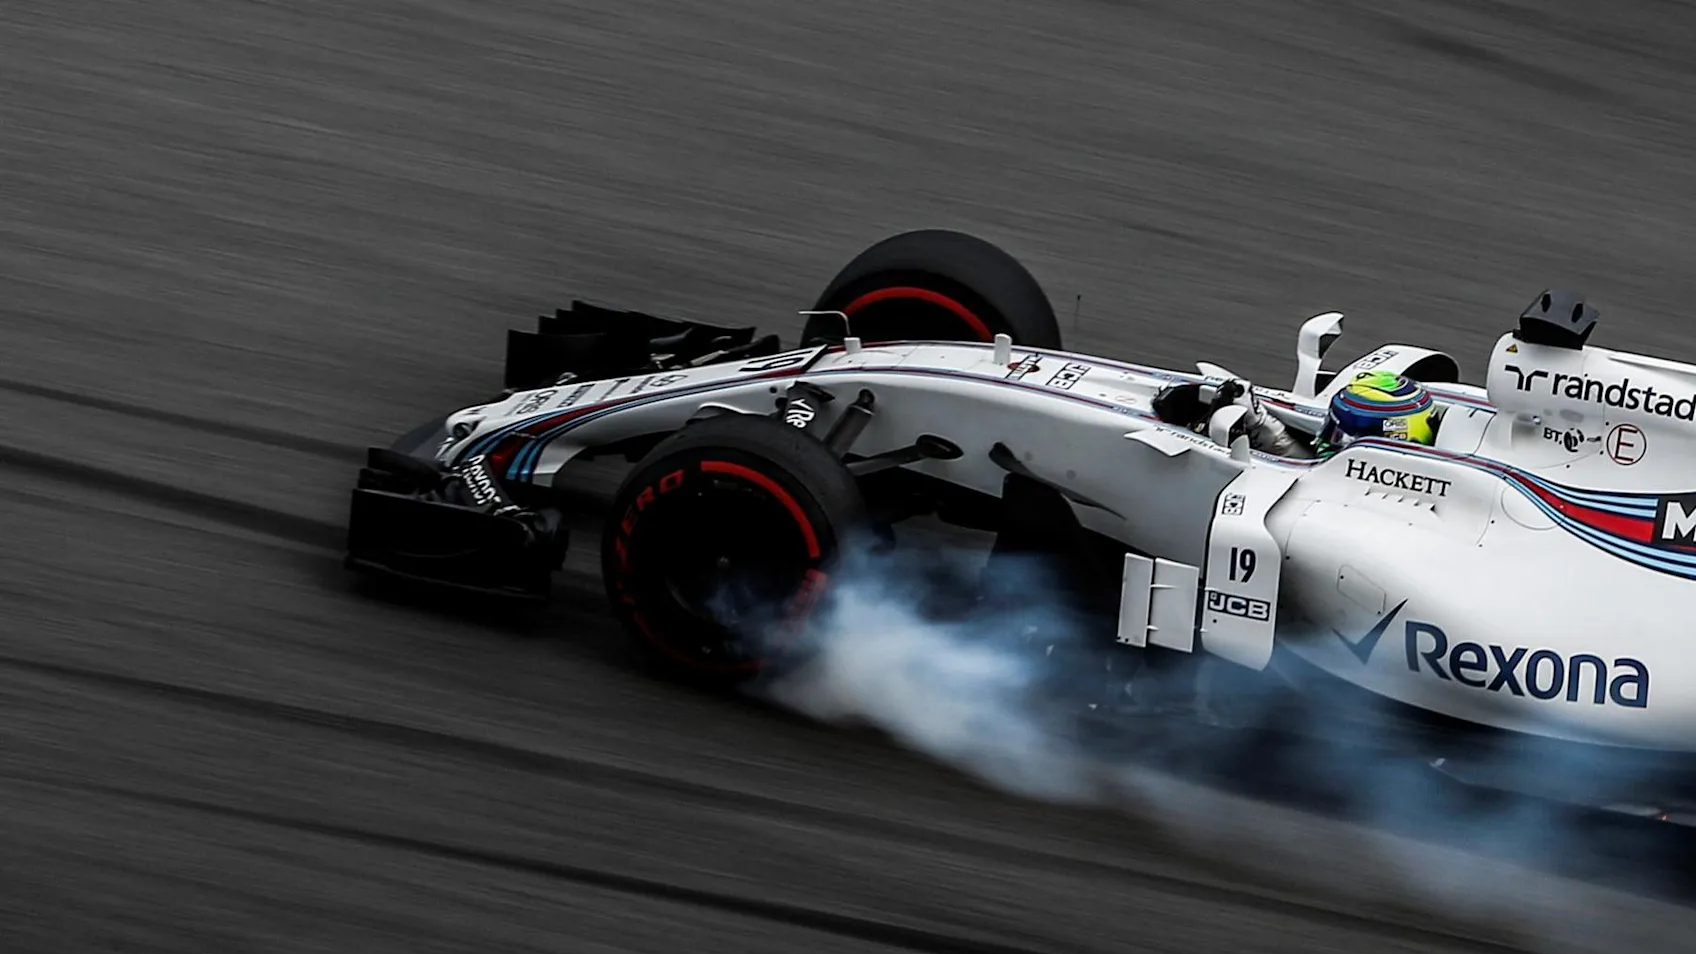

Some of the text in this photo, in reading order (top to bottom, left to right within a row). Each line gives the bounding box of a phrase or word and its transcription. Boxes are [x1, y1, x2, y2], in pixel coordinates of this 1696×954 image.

[1614, 427, 1638, 462] E
[1345, 458, 1452, 497] HACKETT
[1229, 546, 1257, 583] 19
[1209, 595, 1268, 620] JCB
[1405, 620, 1650, 709] Rexona
